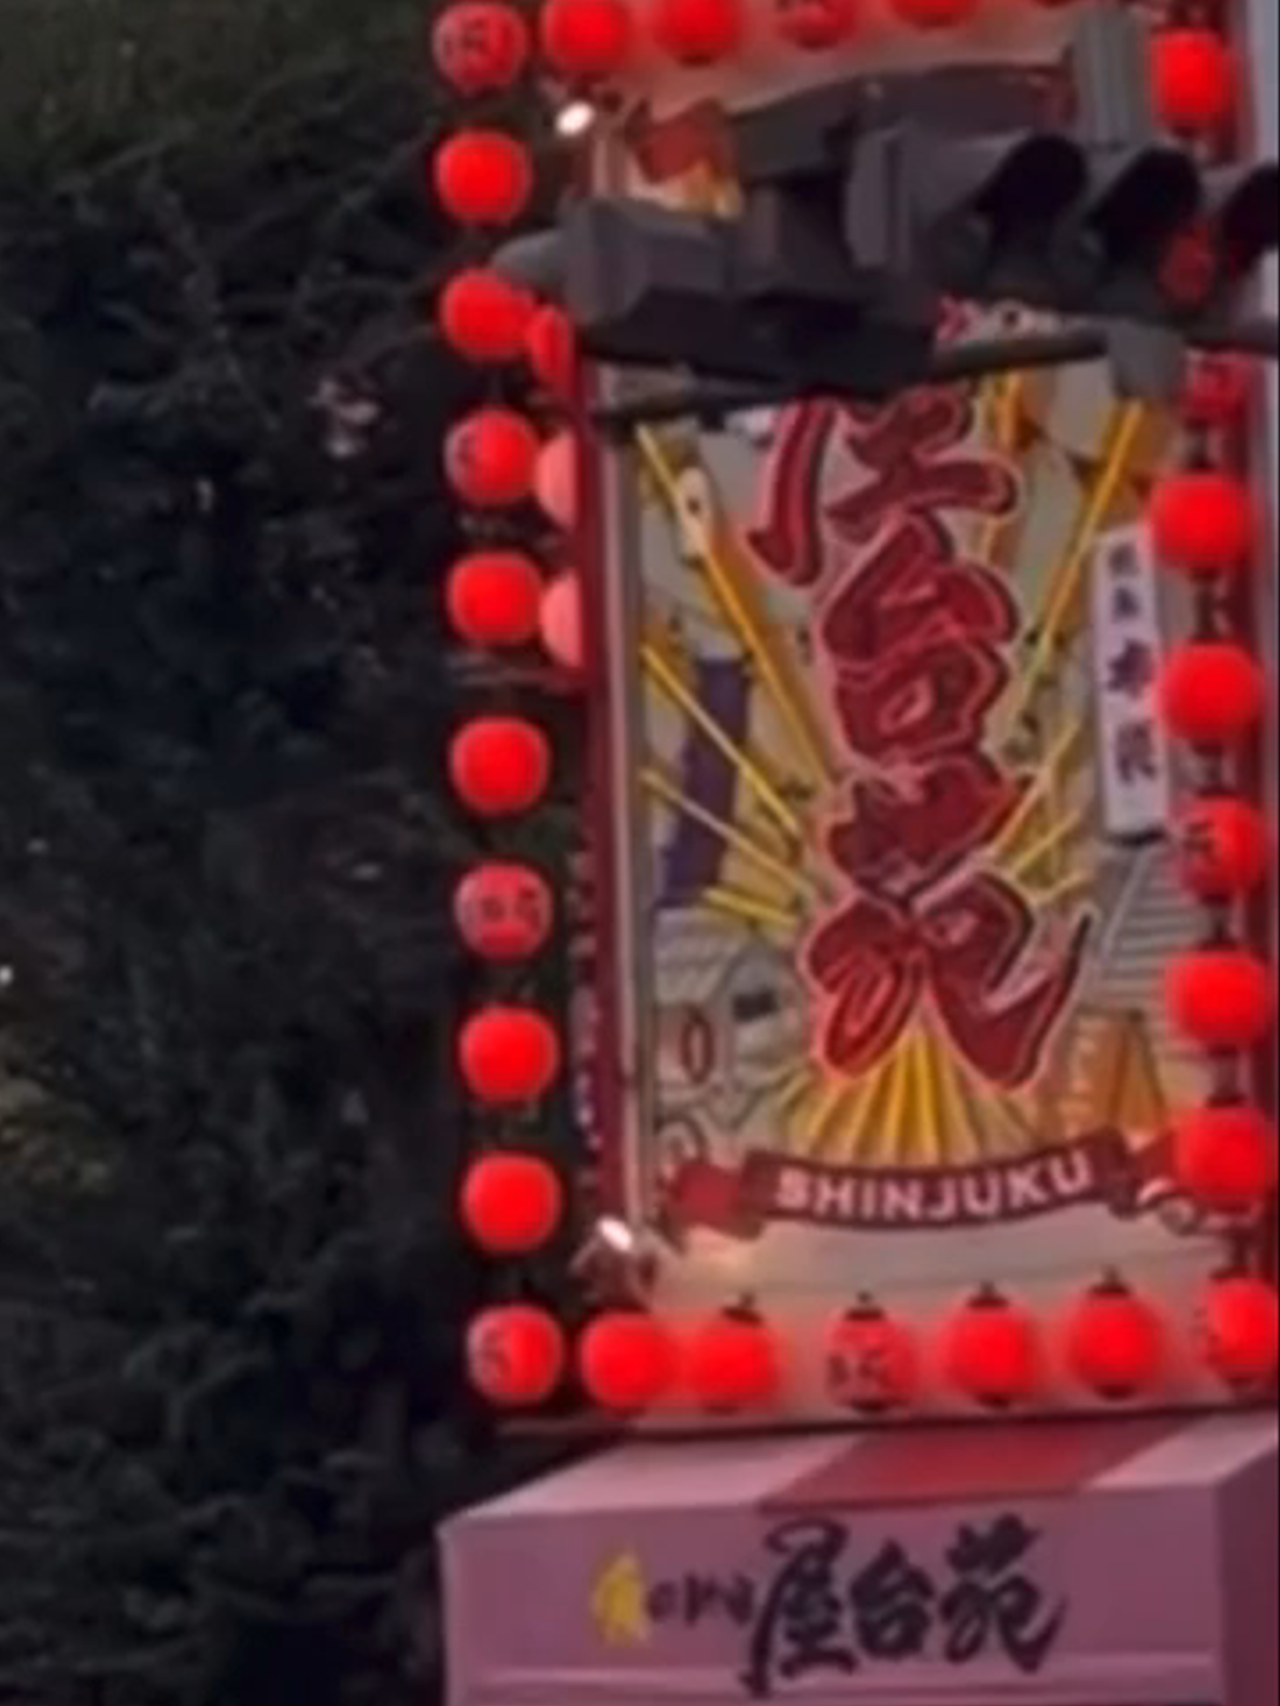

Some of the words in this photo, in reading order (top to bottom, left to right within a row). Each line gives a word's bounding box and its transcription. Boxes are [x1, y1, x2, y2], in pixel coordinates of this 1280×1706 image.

[775, 1148, 1095, 1221] SHINJUKU
[740, 1510, 1070, 1700] 屋台苑
